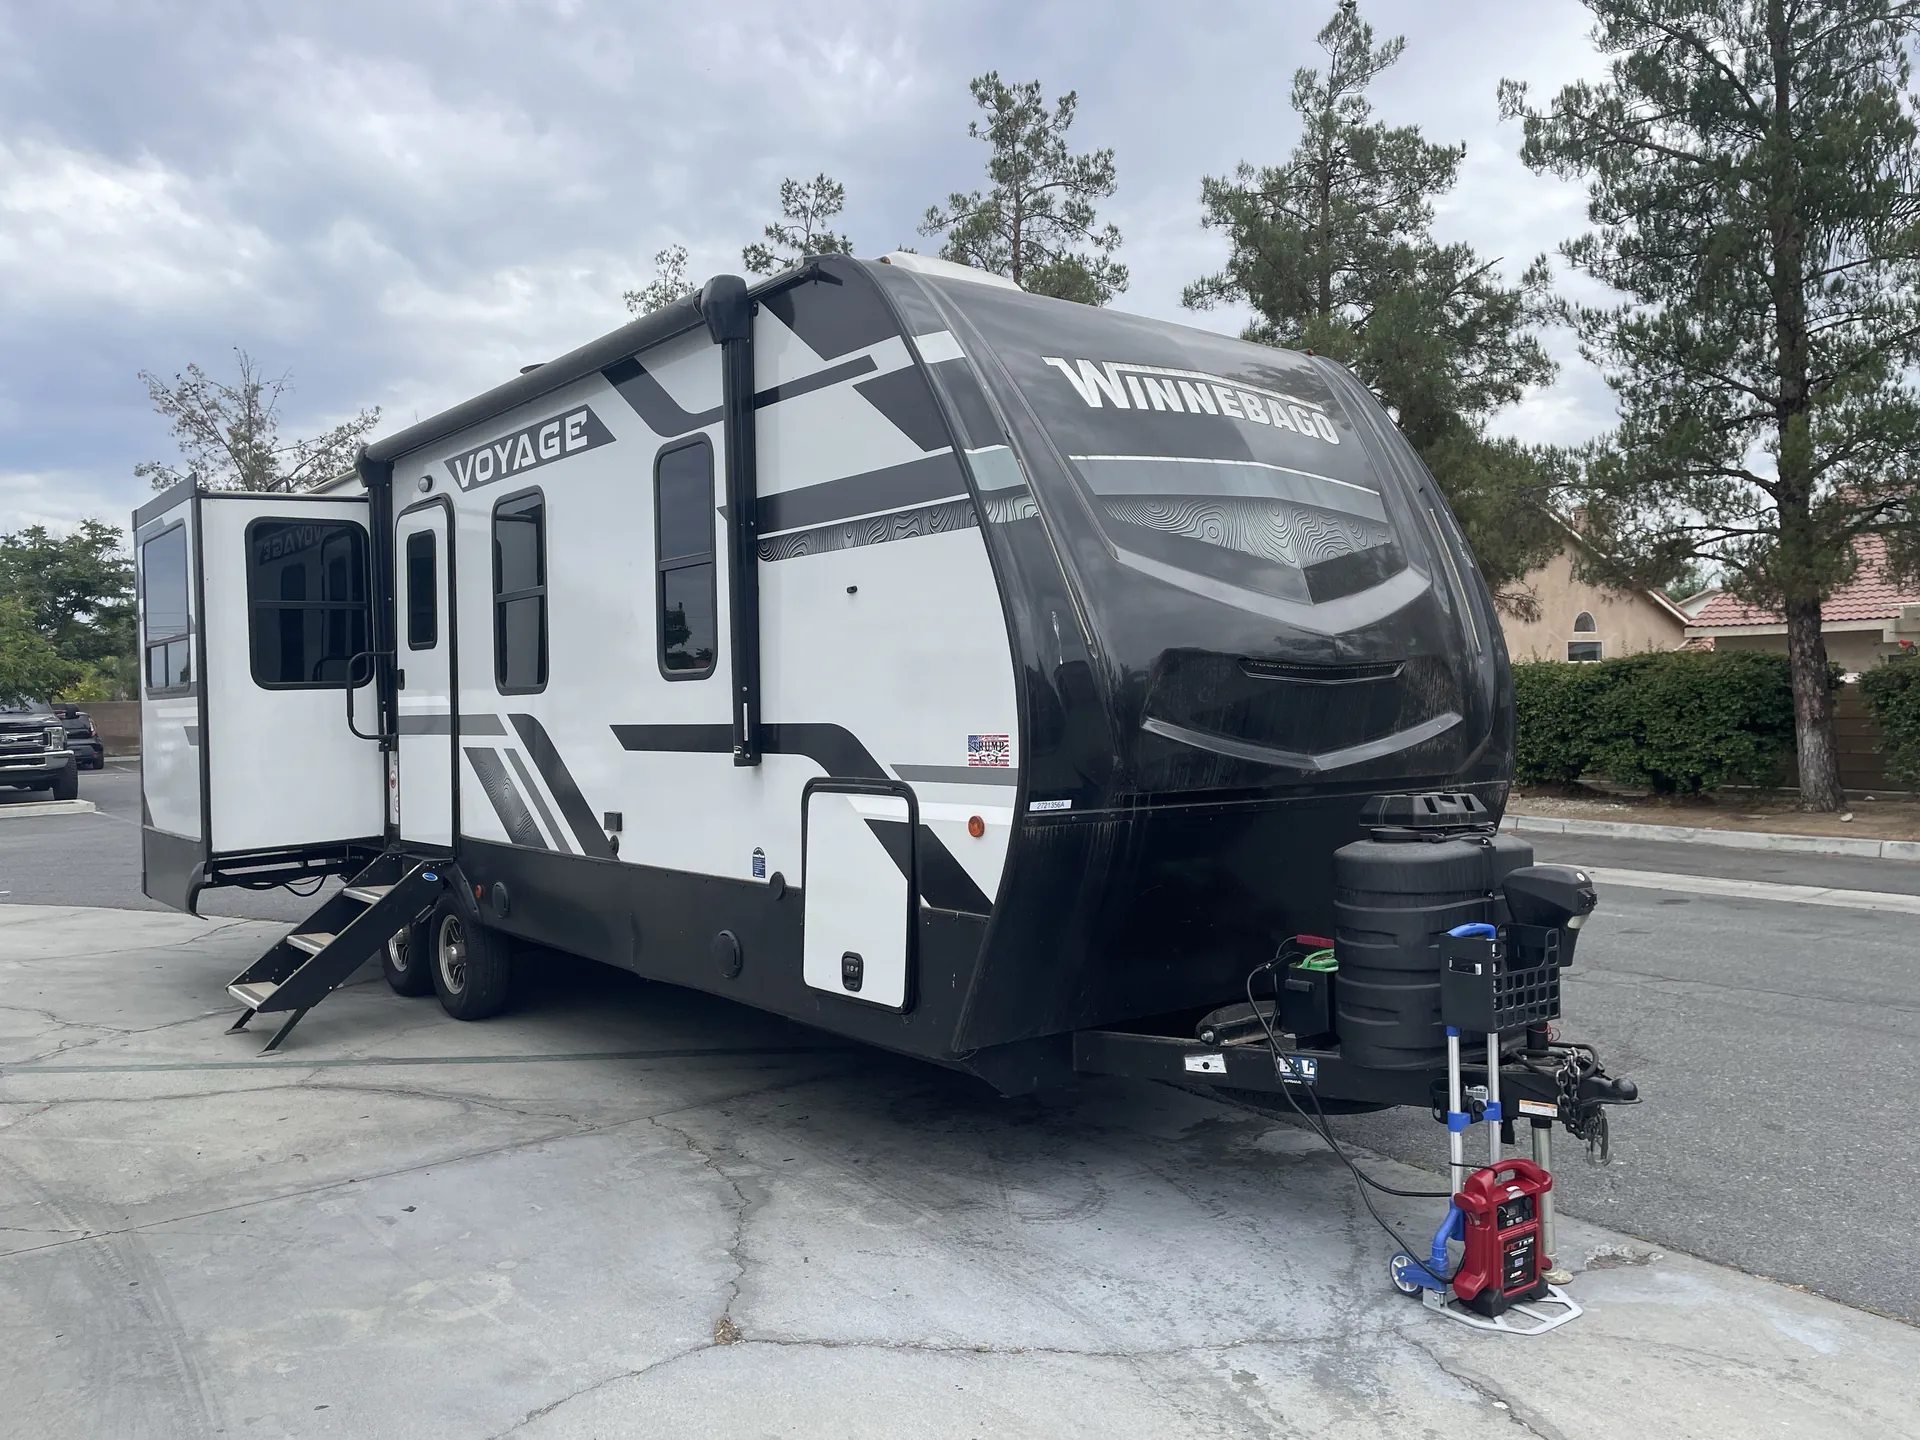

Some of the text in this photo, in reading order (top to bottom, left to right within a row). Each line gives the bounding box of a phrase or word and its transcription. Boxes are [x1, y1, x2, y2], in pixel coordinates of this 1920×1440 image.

[1041, 356, 1340, 445] WINNEBAGO
[454, 410, 588, 488] VOYAGE
[971, 741, 1005, 752] TRUMP
[1277, 1057, 1315, 1075] BL
